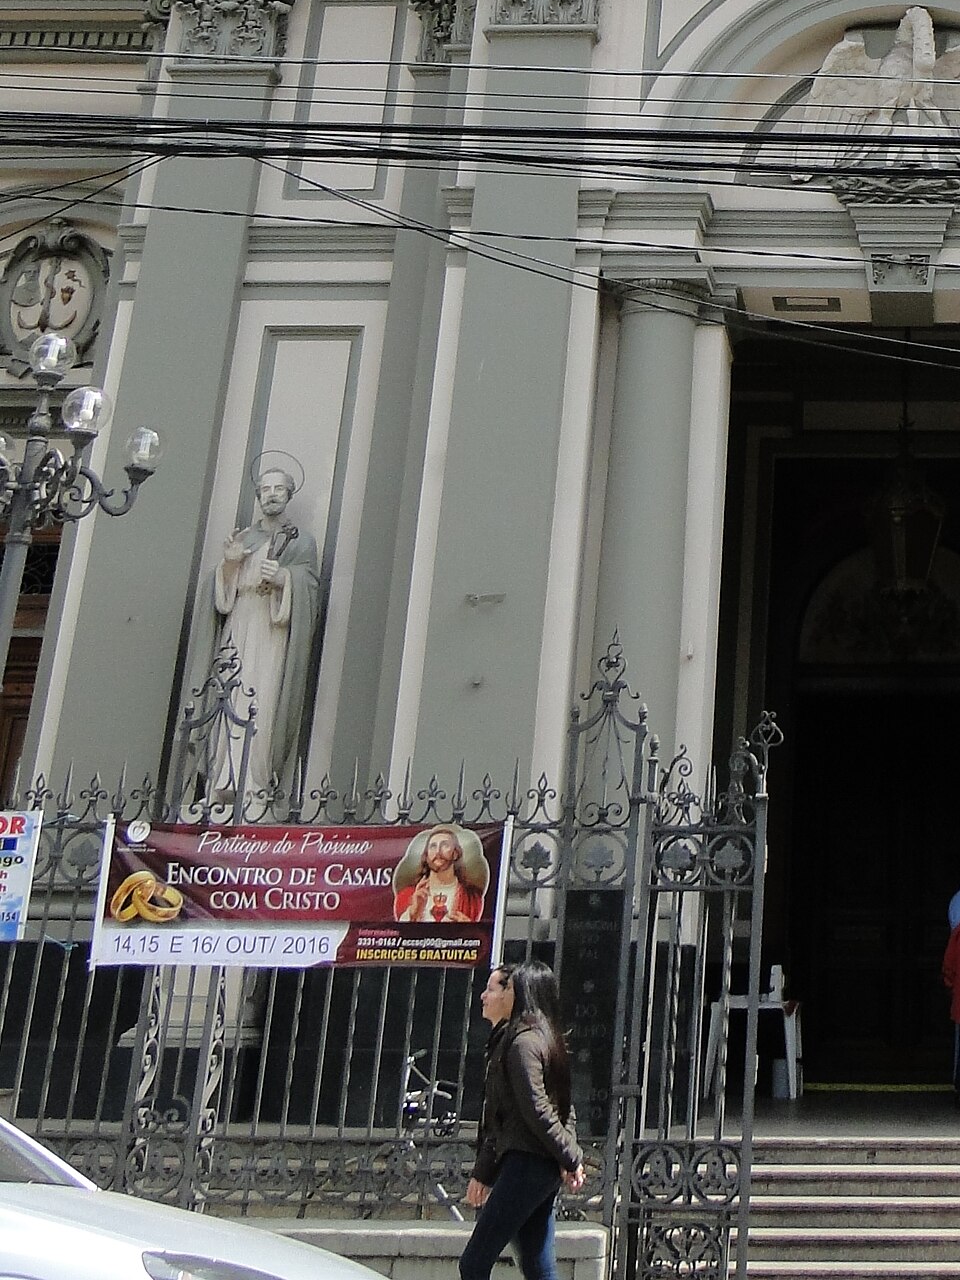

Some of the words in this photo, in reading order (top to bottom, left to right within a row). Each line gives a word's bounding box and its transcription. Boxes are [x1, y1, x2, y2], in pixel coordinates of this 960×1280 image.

[197, 830, 271, 862] Participe
[272, 832, 296, 854] do
[299, 831, 374, 855] Próximo
[166, 862, 285, 886] ENCONTRO
[289, 867, 317, 886] DE
[323, 863, 393, 887] CASAIS
[209, 890, 258, 910] COM
[265, 886, 341, 911] CRISTO
[113, 935, 160, 955] 14,15
[169, 936, 184, 954] E
[282, 935, 331, 954] 2016
[356, 946, 418, 960] INSCRIÇÕES
[420, 949, 478, 960] GRATUITAS
